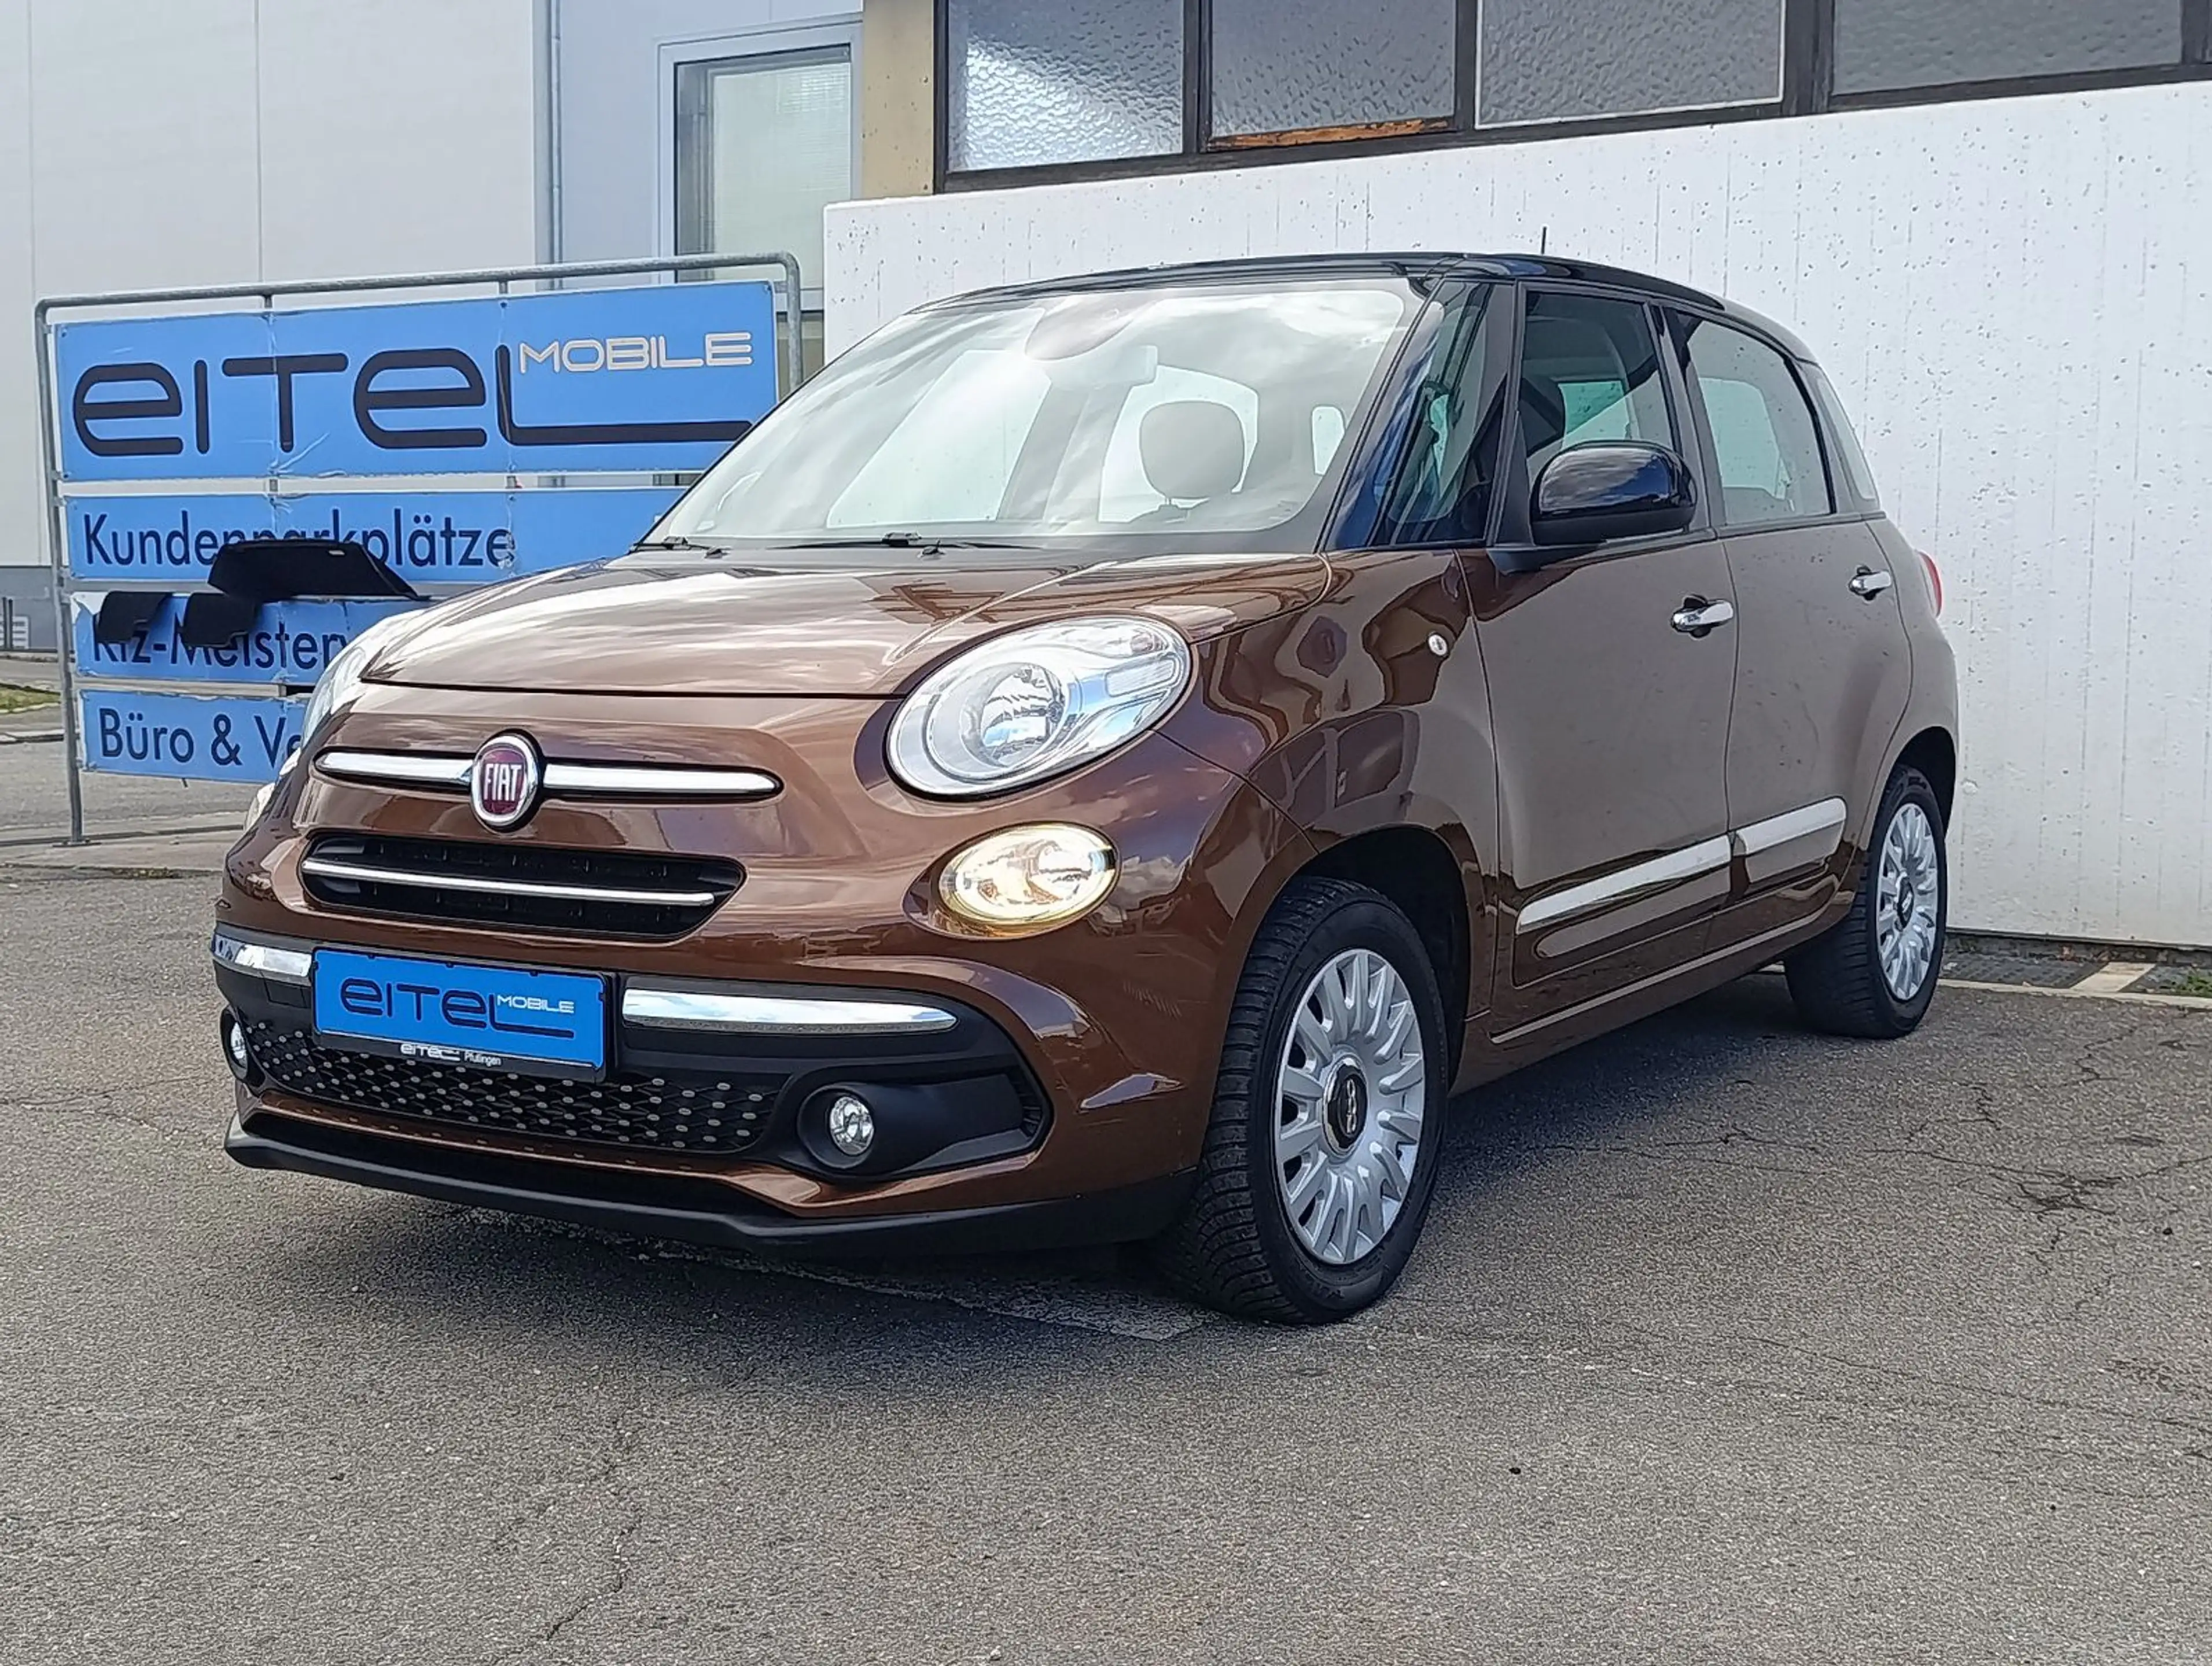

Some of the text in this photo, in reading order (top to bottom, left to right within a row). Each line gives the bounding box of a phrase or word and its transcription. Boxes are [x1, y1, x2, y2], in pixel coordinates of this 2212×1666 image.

[520, 331, 752, 374] MOBILE
[83, 508, 516, 567] Kundekplätze
[98, 707, 194, 764] Büro
[211, 714, 243, 766] &
[483, 763, 522, 801] FIAT
[496, 994, 575, 1013] MOBILE
